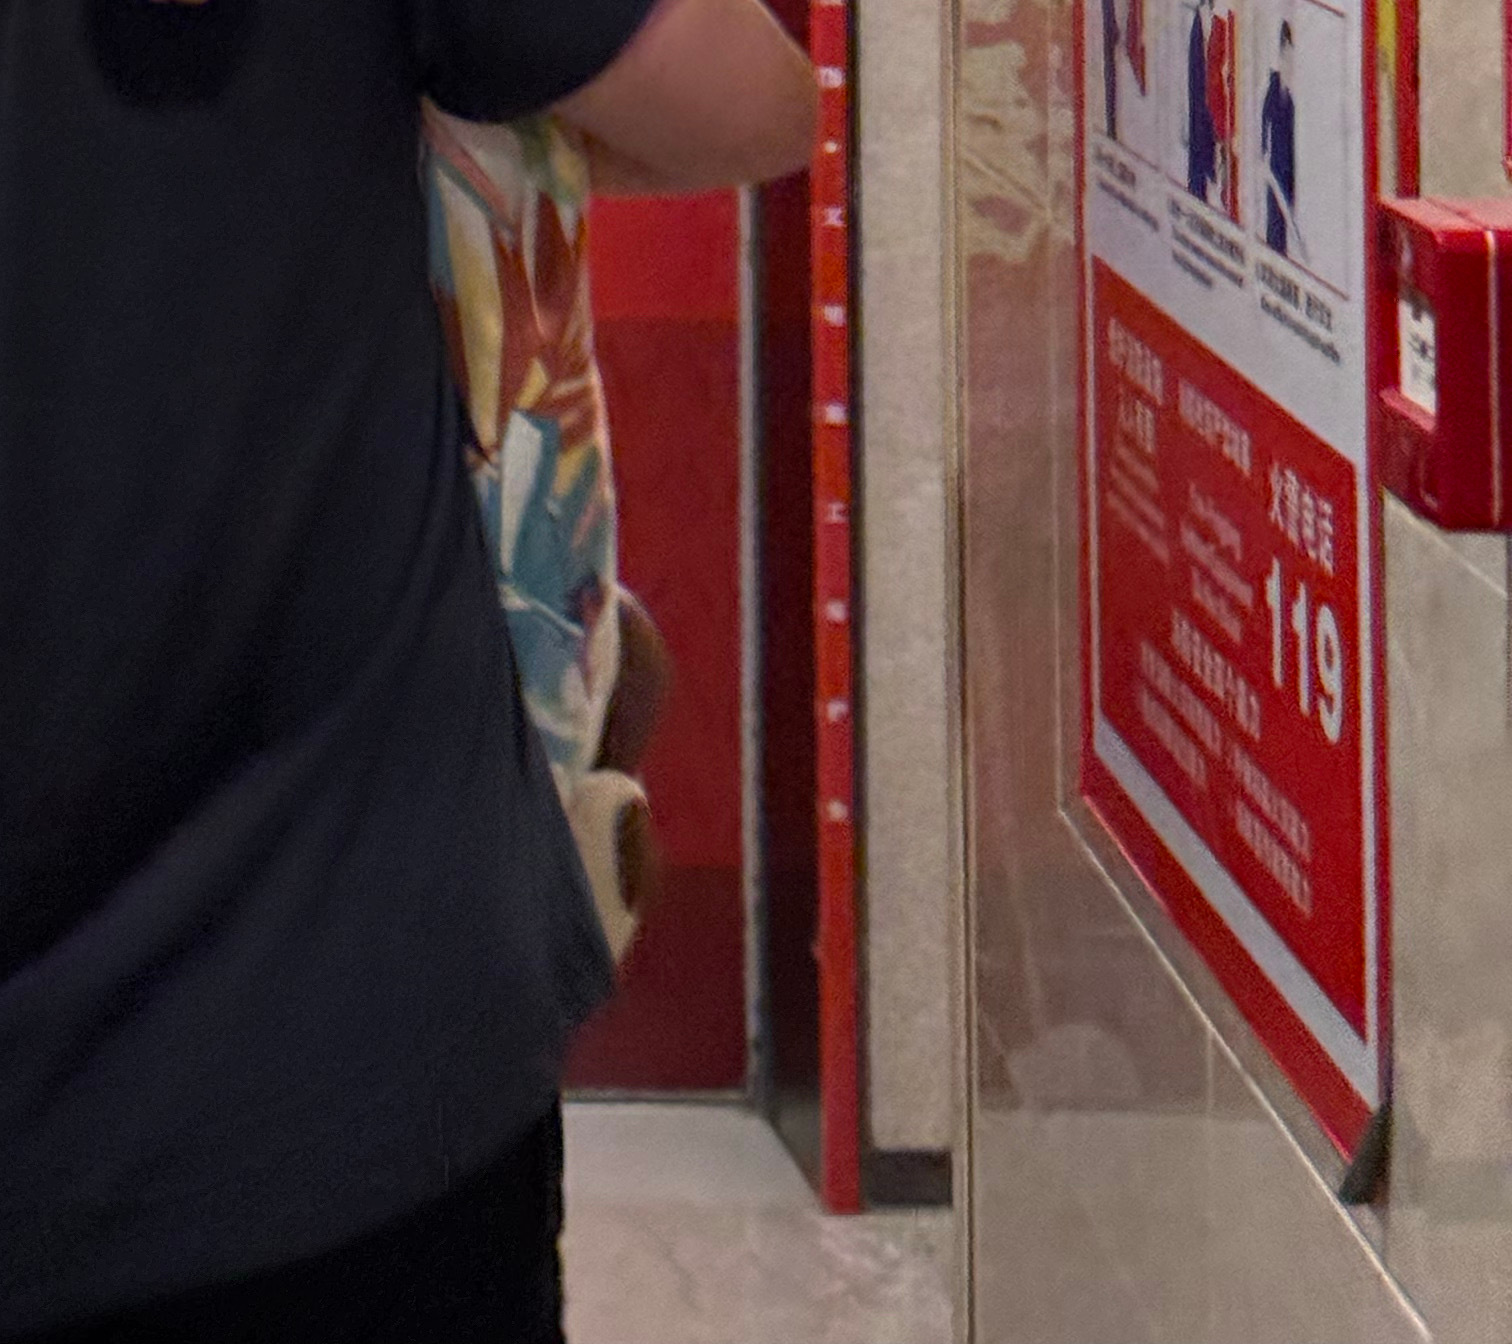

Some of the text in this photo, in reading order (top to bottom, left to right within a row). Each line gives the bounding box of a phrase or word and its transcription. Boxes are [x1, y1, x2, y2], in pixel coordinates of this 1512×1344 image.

[1269, 462, 1335, 577] 火警电话
[1264, 557, 1344, 743] 119
